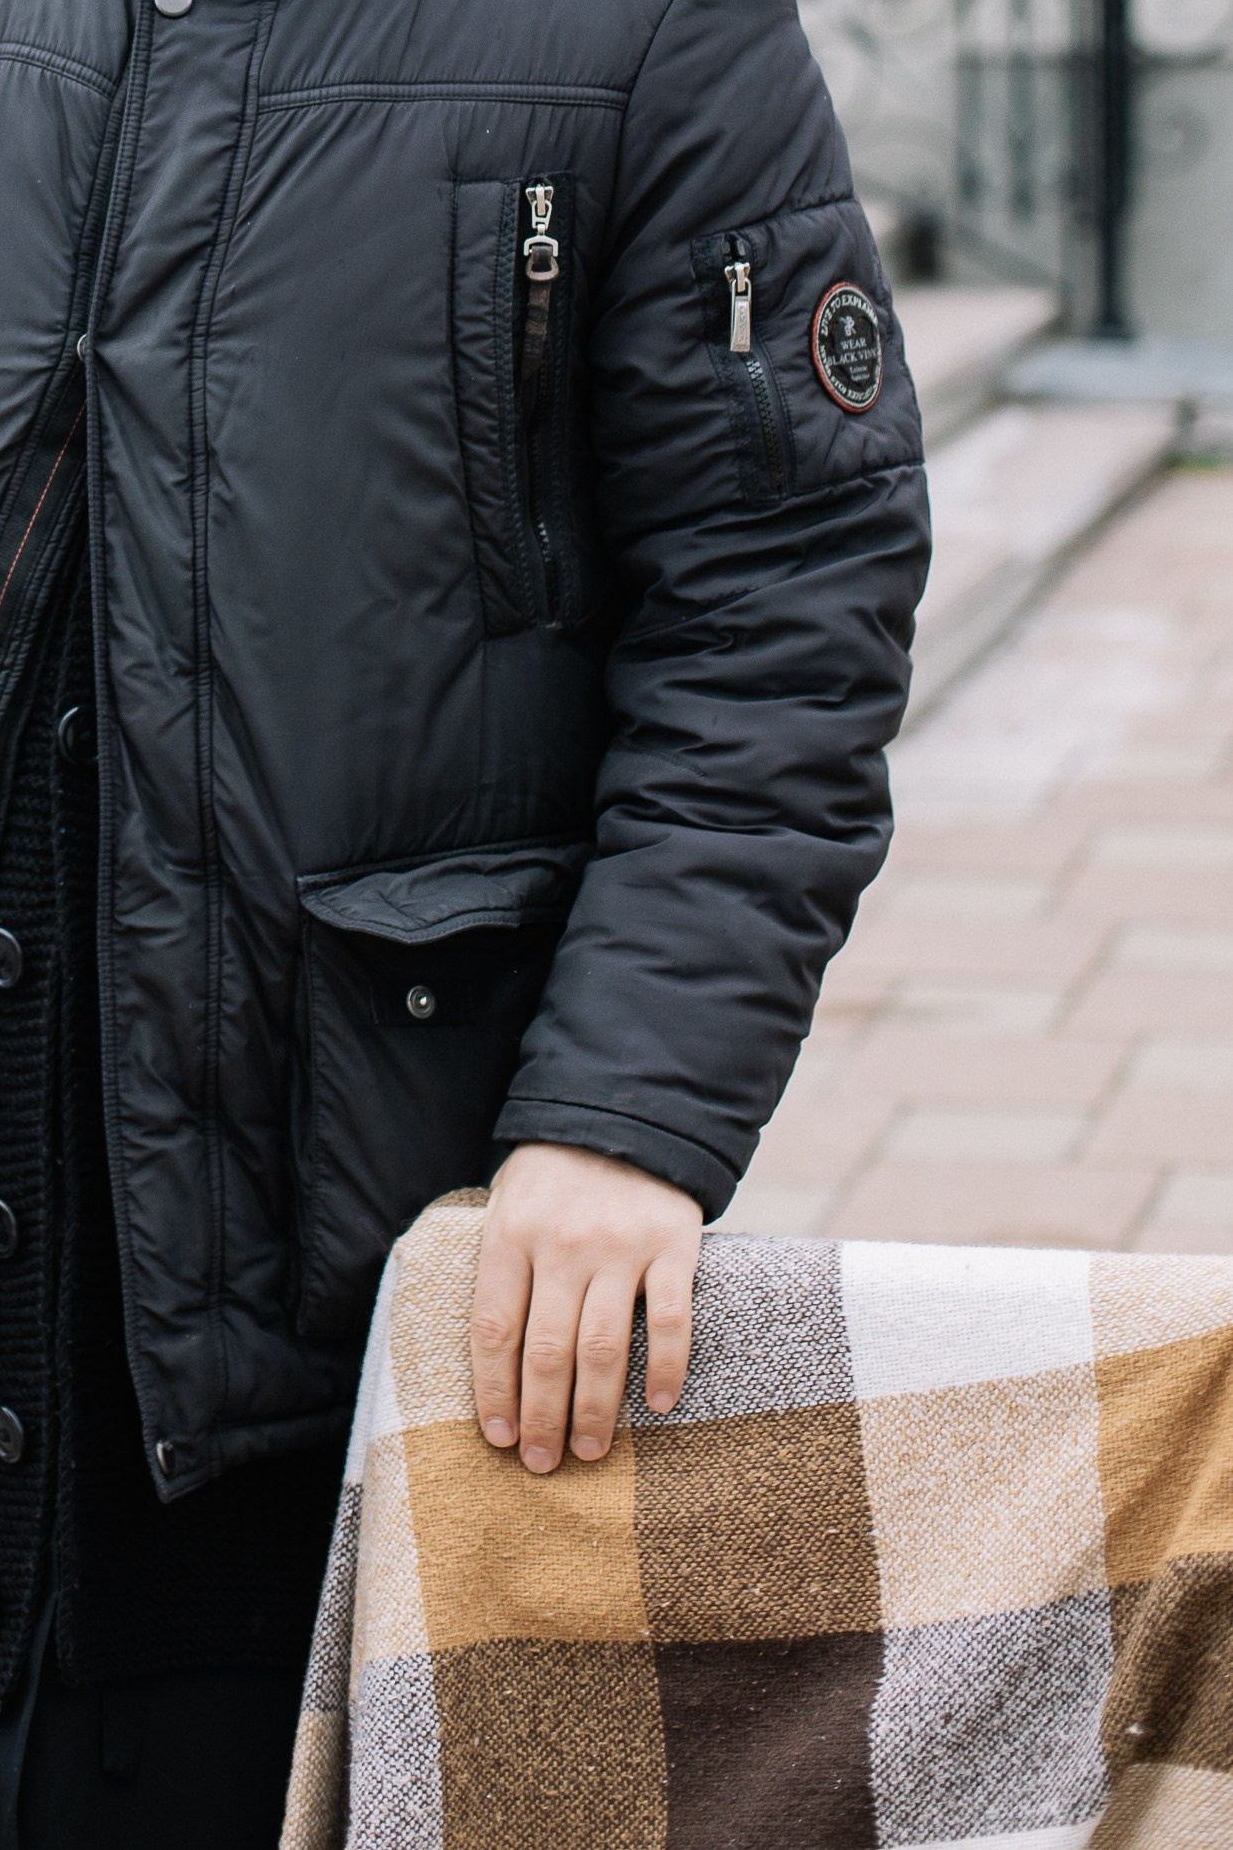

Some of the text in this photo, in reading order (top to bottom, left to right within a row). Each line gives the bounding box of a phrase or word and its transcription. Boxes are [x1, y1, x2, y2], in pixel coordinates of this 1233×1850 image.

[830, 297, 842, 313] TO
[839, 338, 866, 350] WEAR
[826, 351, 857, 365] BLACK
